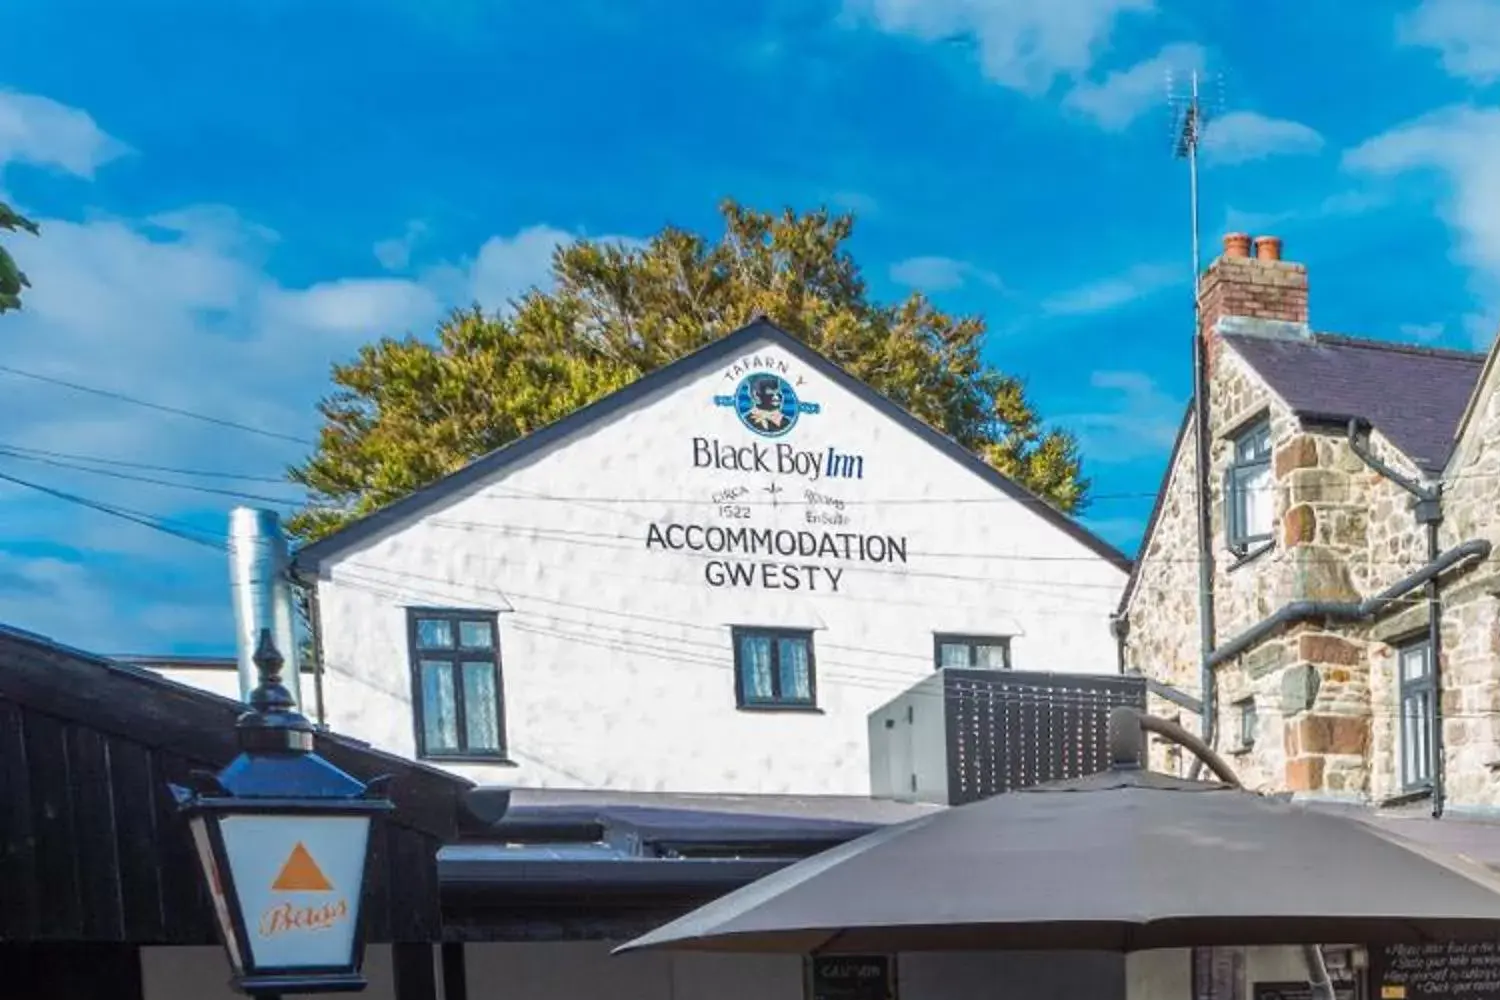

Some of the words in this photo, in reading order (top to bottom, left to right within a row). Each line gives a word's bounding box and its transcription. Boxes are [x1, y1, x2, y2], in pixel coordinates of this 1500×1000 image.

[723, 355, 790, 382] TAFARN
[692, 437, 771, 473] Black
[775, 443, 822, 482] Boy
[825, 447, 864, 479] Inn
[711, 486, 749, 504] CIRCA
[718, 505, 752, 520] 1522
[645, 523, 908, 563] ACCOMMODATION
[704, 560, 843, 592] GWESTY
